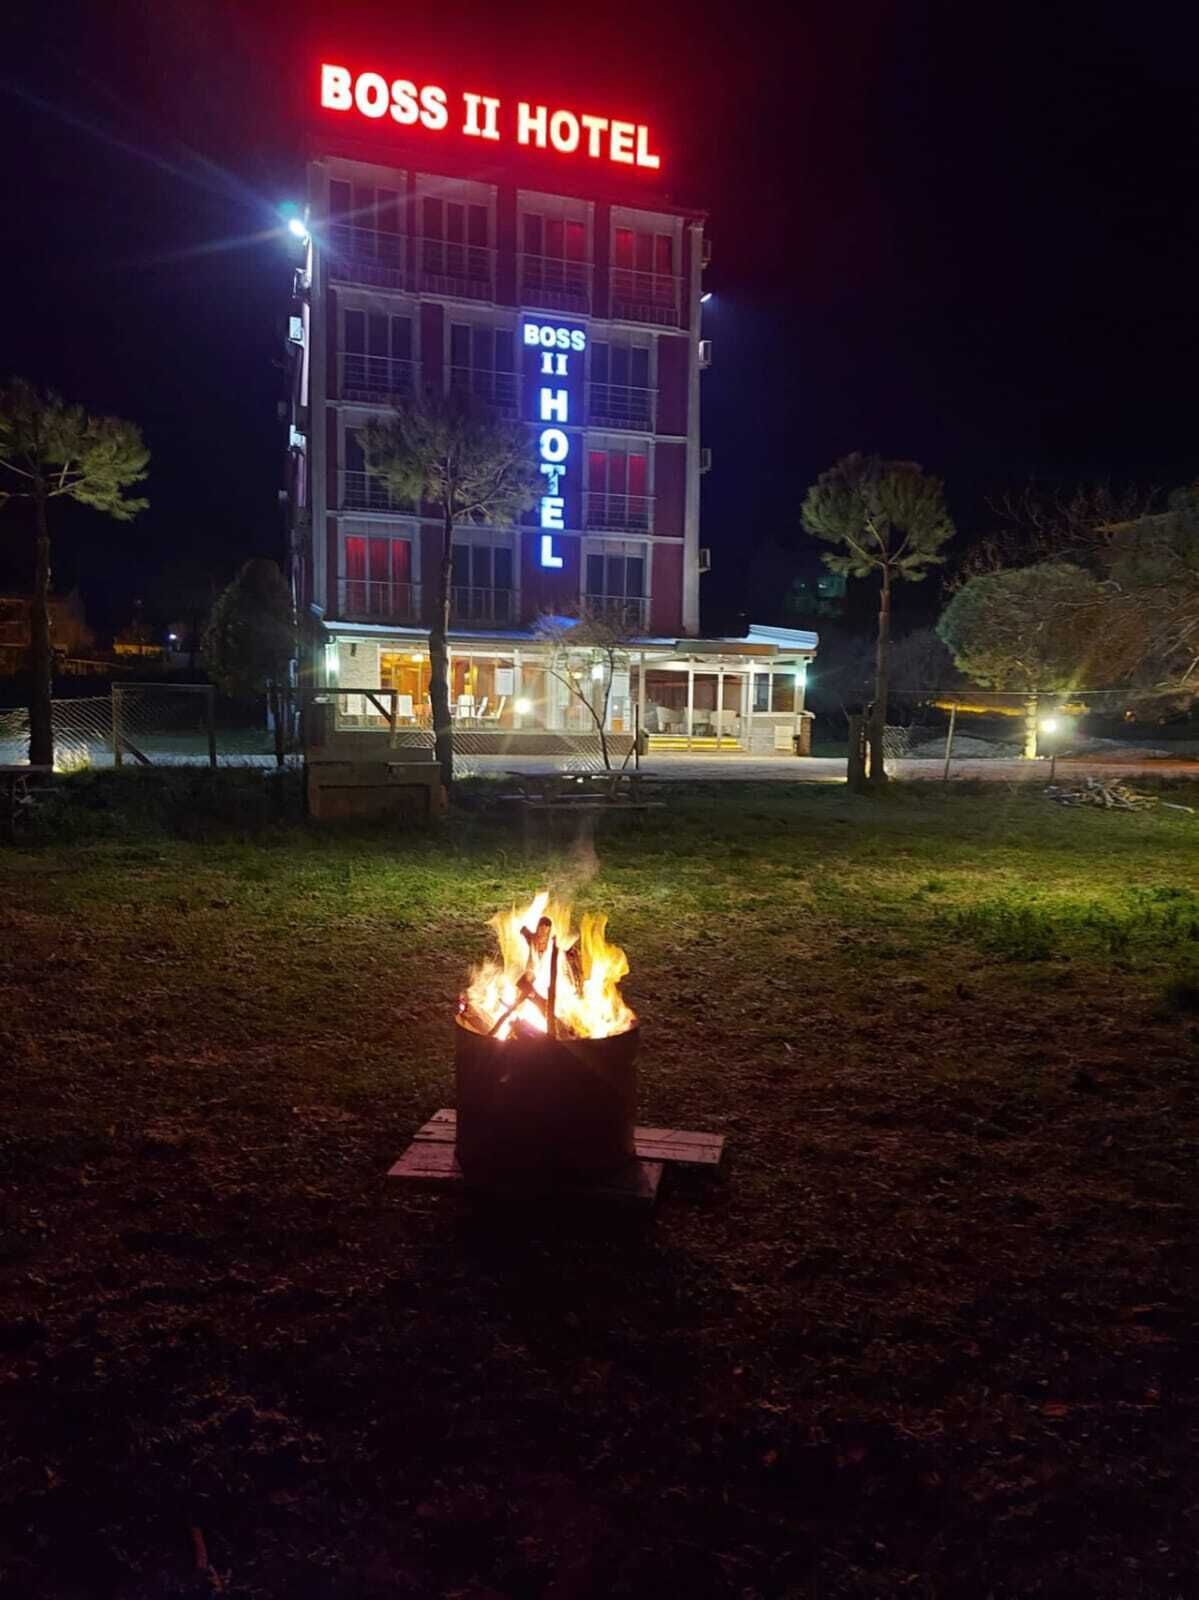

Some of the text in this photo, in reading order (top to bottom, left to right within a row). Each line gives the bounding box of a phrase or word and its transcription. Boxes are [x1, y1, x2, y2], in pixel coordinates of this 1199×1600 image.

[320, 63, 661, 169] BOSS II HOTEL
[523, 323, 587, 351] BOSS
[540, 352, 569, 376] II
[539, 387, 570, 568] HOTEL
